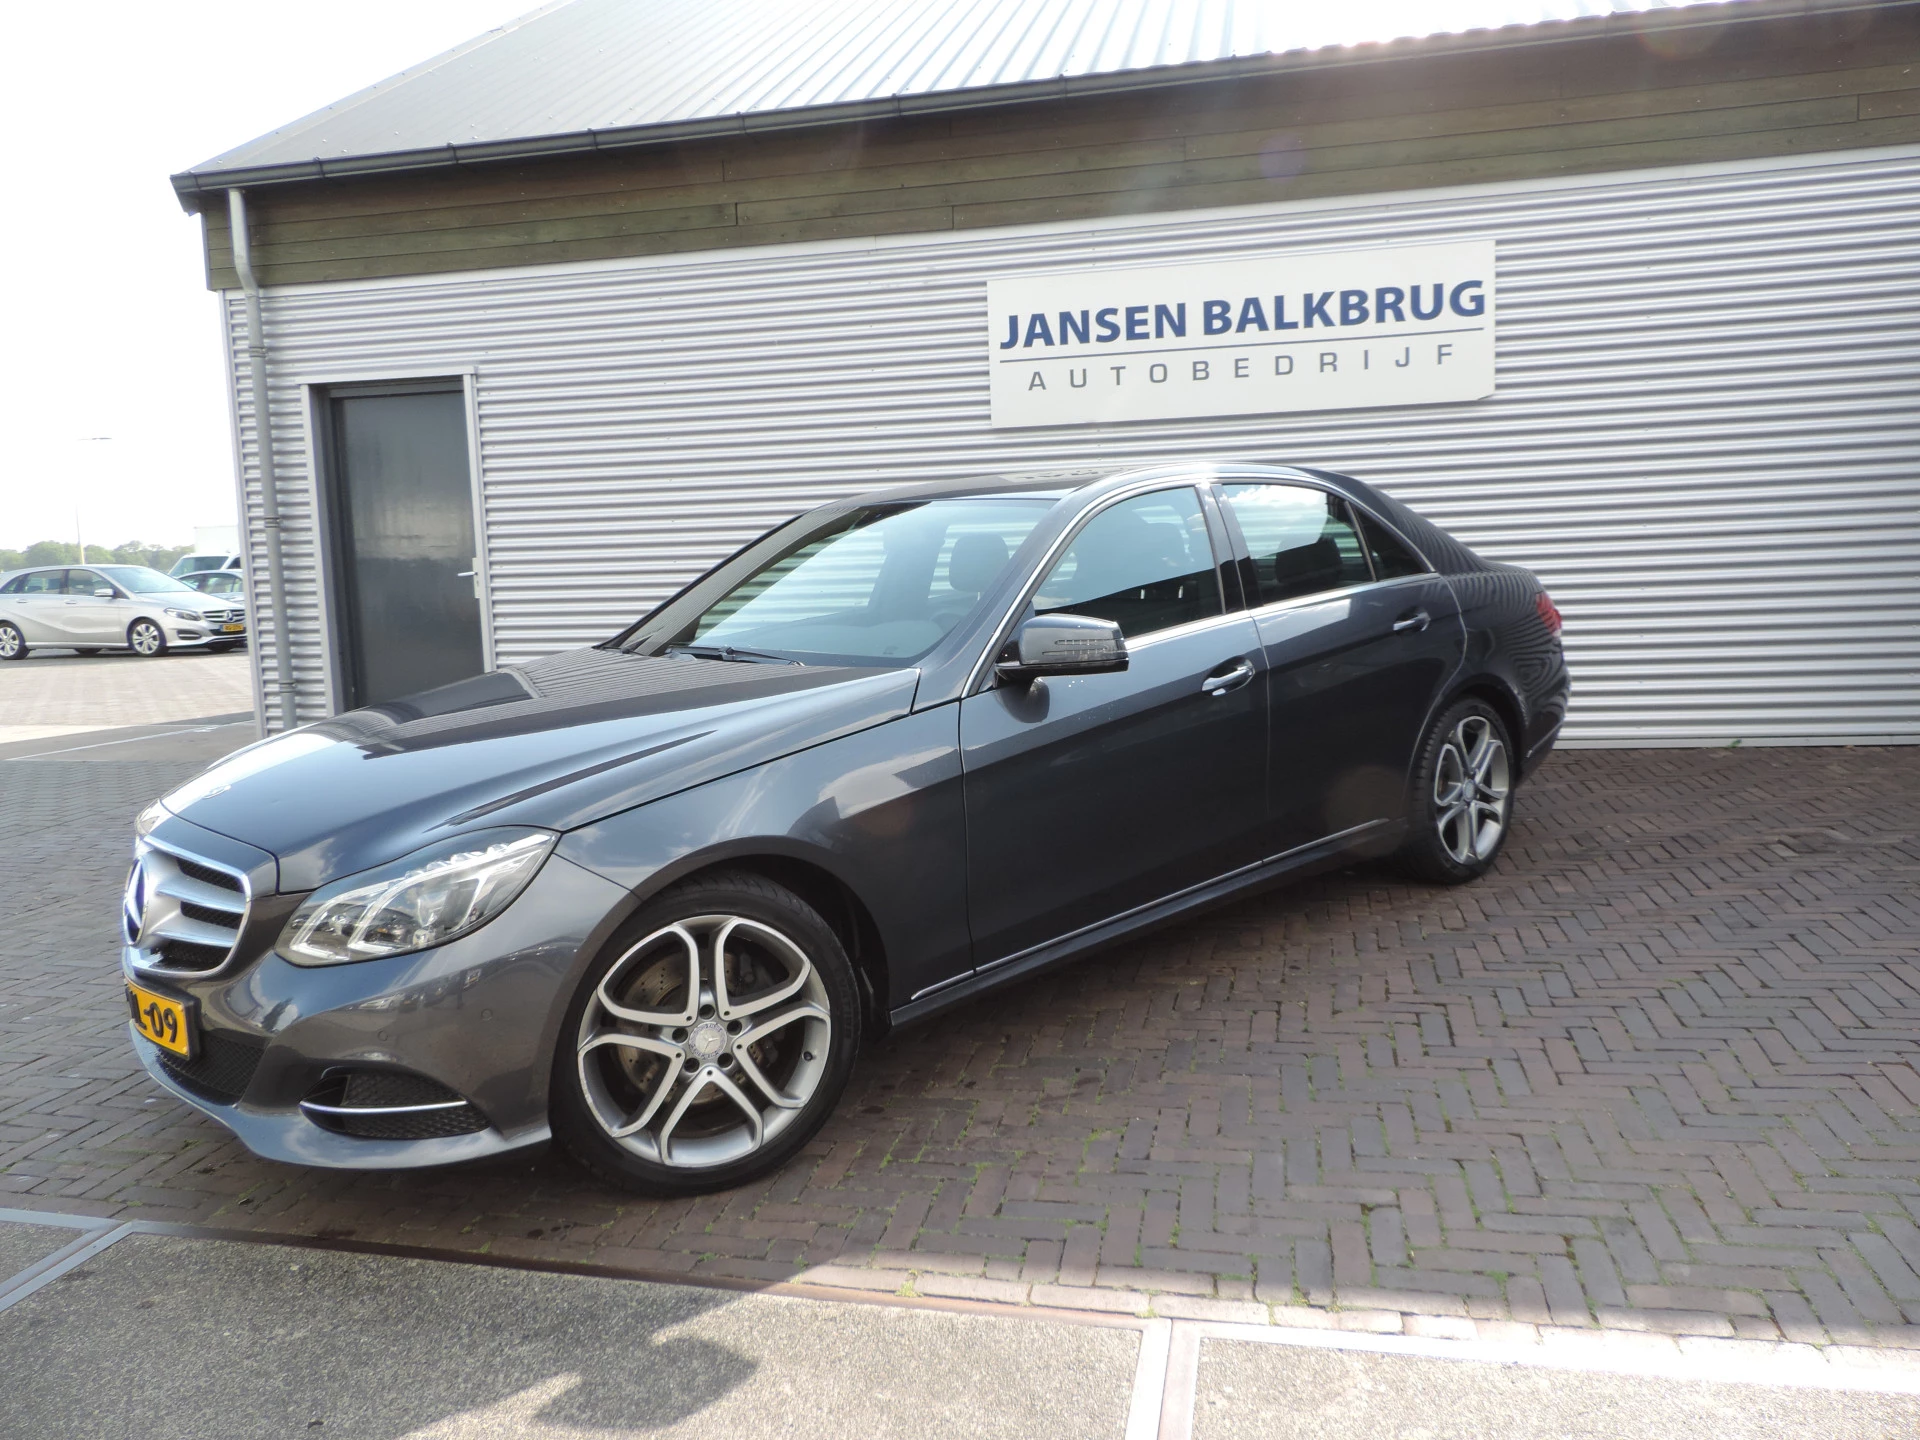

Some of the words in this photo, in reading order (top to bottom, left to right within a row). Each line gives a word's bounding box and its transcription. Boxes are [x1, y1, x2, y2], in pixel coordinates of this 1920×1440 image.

[1000, 302, 1187, 350] JANSEN
[1203, 280, 1486, 336] BALKBRUG
[1028, 344, 1454, 391] AUTOBEDRIJF
